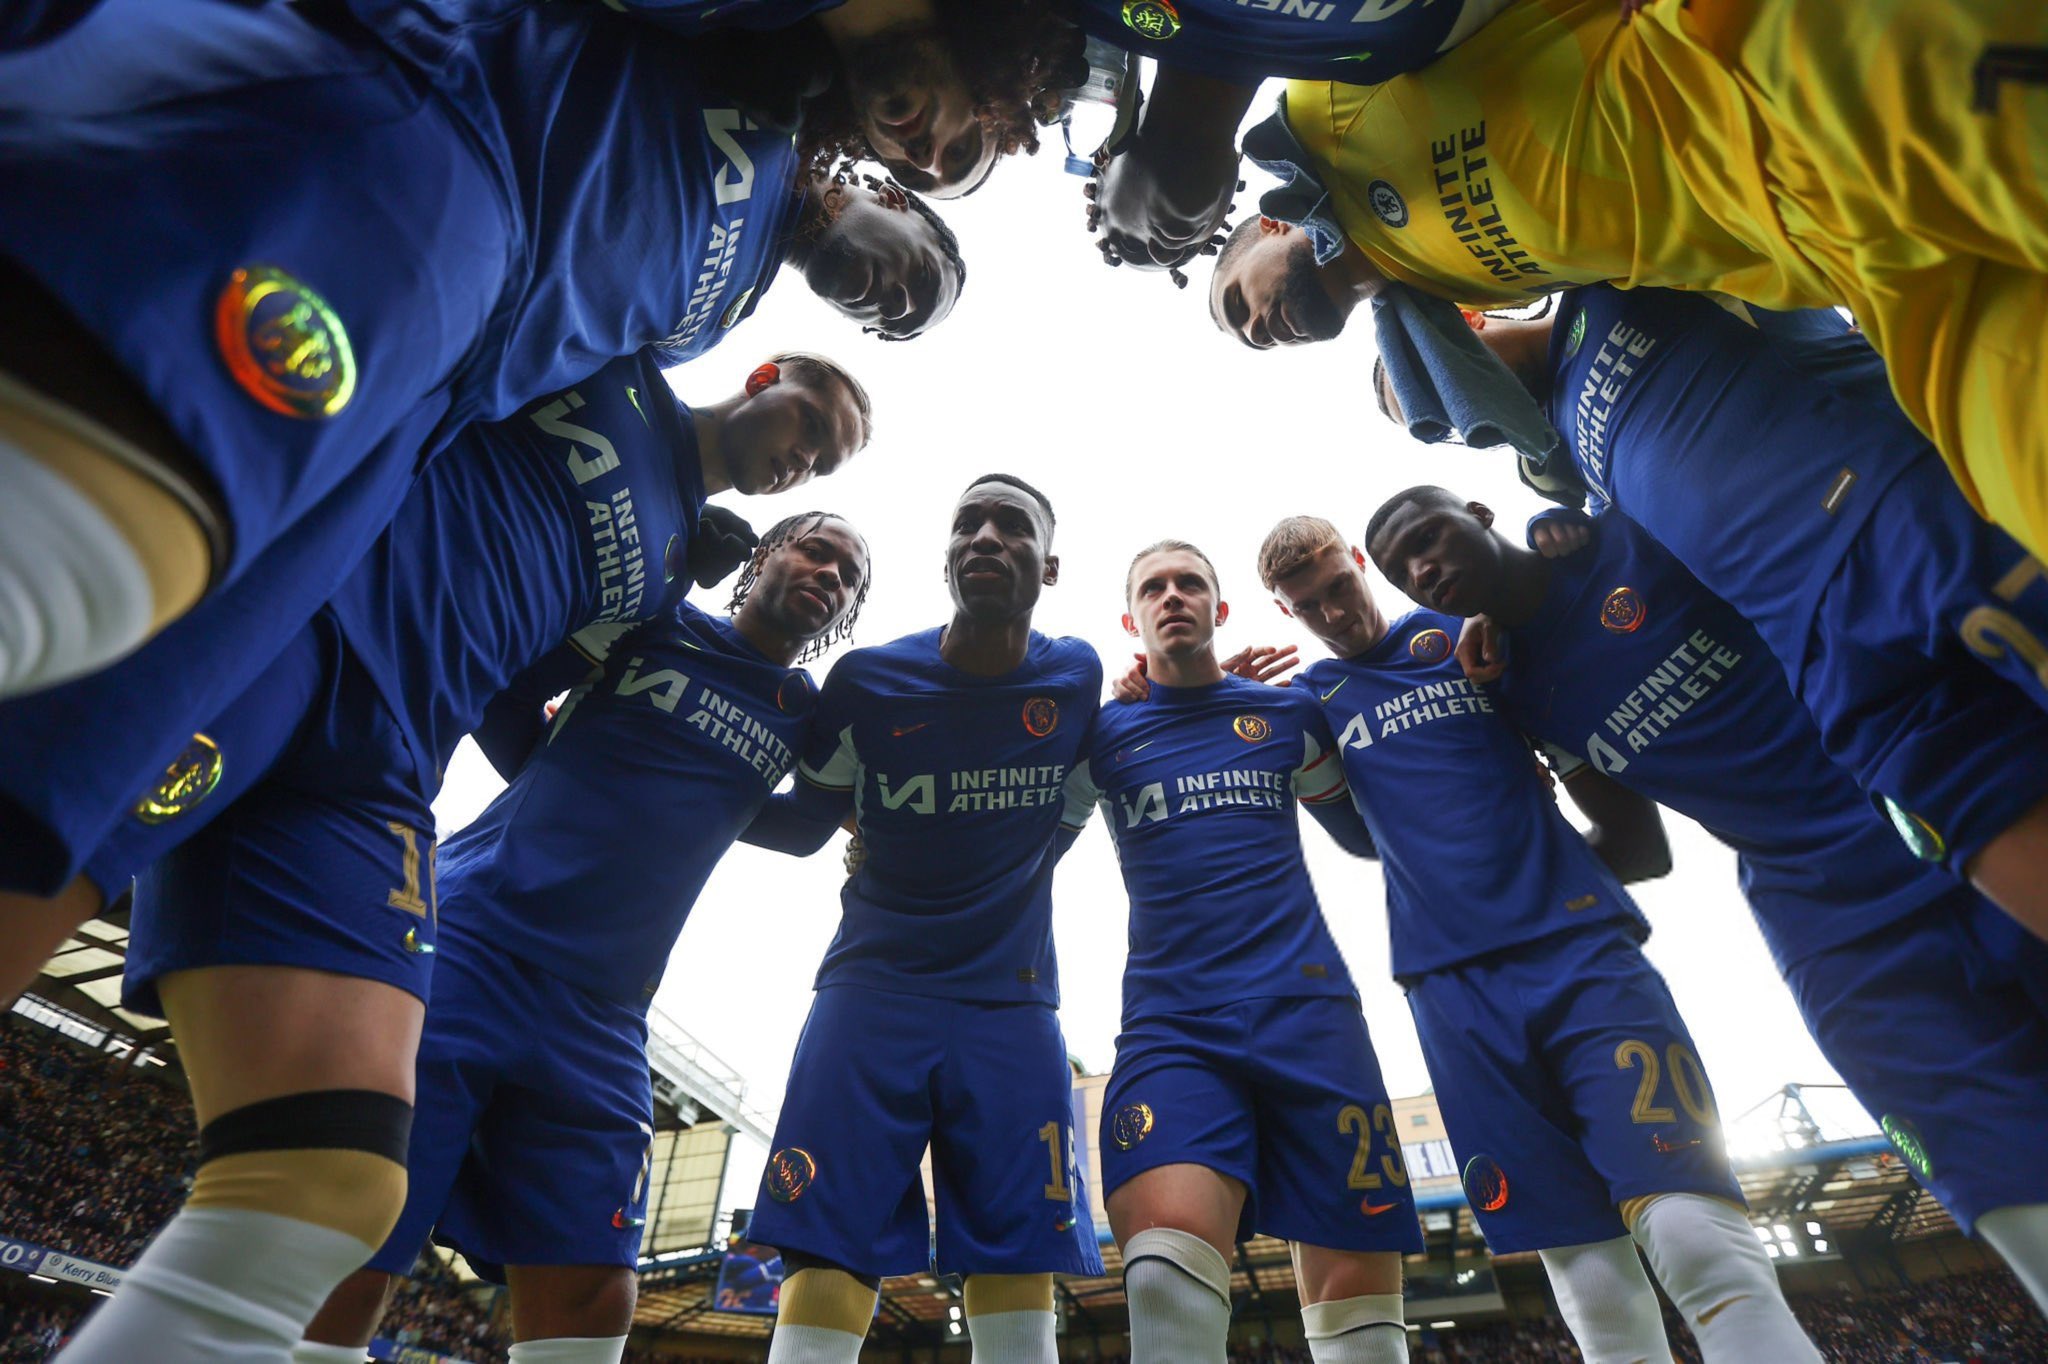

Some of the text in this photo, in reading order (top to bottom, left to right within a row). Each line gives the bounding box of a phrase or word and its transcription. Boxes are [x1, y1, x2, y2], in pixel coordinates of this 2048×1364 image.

[1431, 134, 1523, 282] INFINITE
[1461, 120, 1552, 275] ATHLETE
[667, 218, 744, 348] INFINITE
[1576, 320, 1634, 465] INFINITE
[1588, 332, 1656, 481] ATHLETE
[612, 487, 645, 621] INFINITE
[1374, 678, 1486, 720] INFINITE
[1381, 697, 1494, 739] ATHLETE
[1604, 629, 1716, 736] INFINITE
[1626, 645, 1742, 754] ATHLETE
[686, 710, 781, 788] ATHLETE
[699, 688, 792, 770] INFINITE
[948, 786, 1061, 813] ATHLETE
[951, 765, 1065, 791] INFINITE
[1176, 770, 1284, 794] INFINITE
[1179, 789, 1283, 814] ATHLETE
[387, 820, 437, 930] 1
[1614, 1039, 1717, 1128] 20
[1337, 1103, 1407, 1190] 23
[61, 1262, 120, 1287] Kerry Blue
